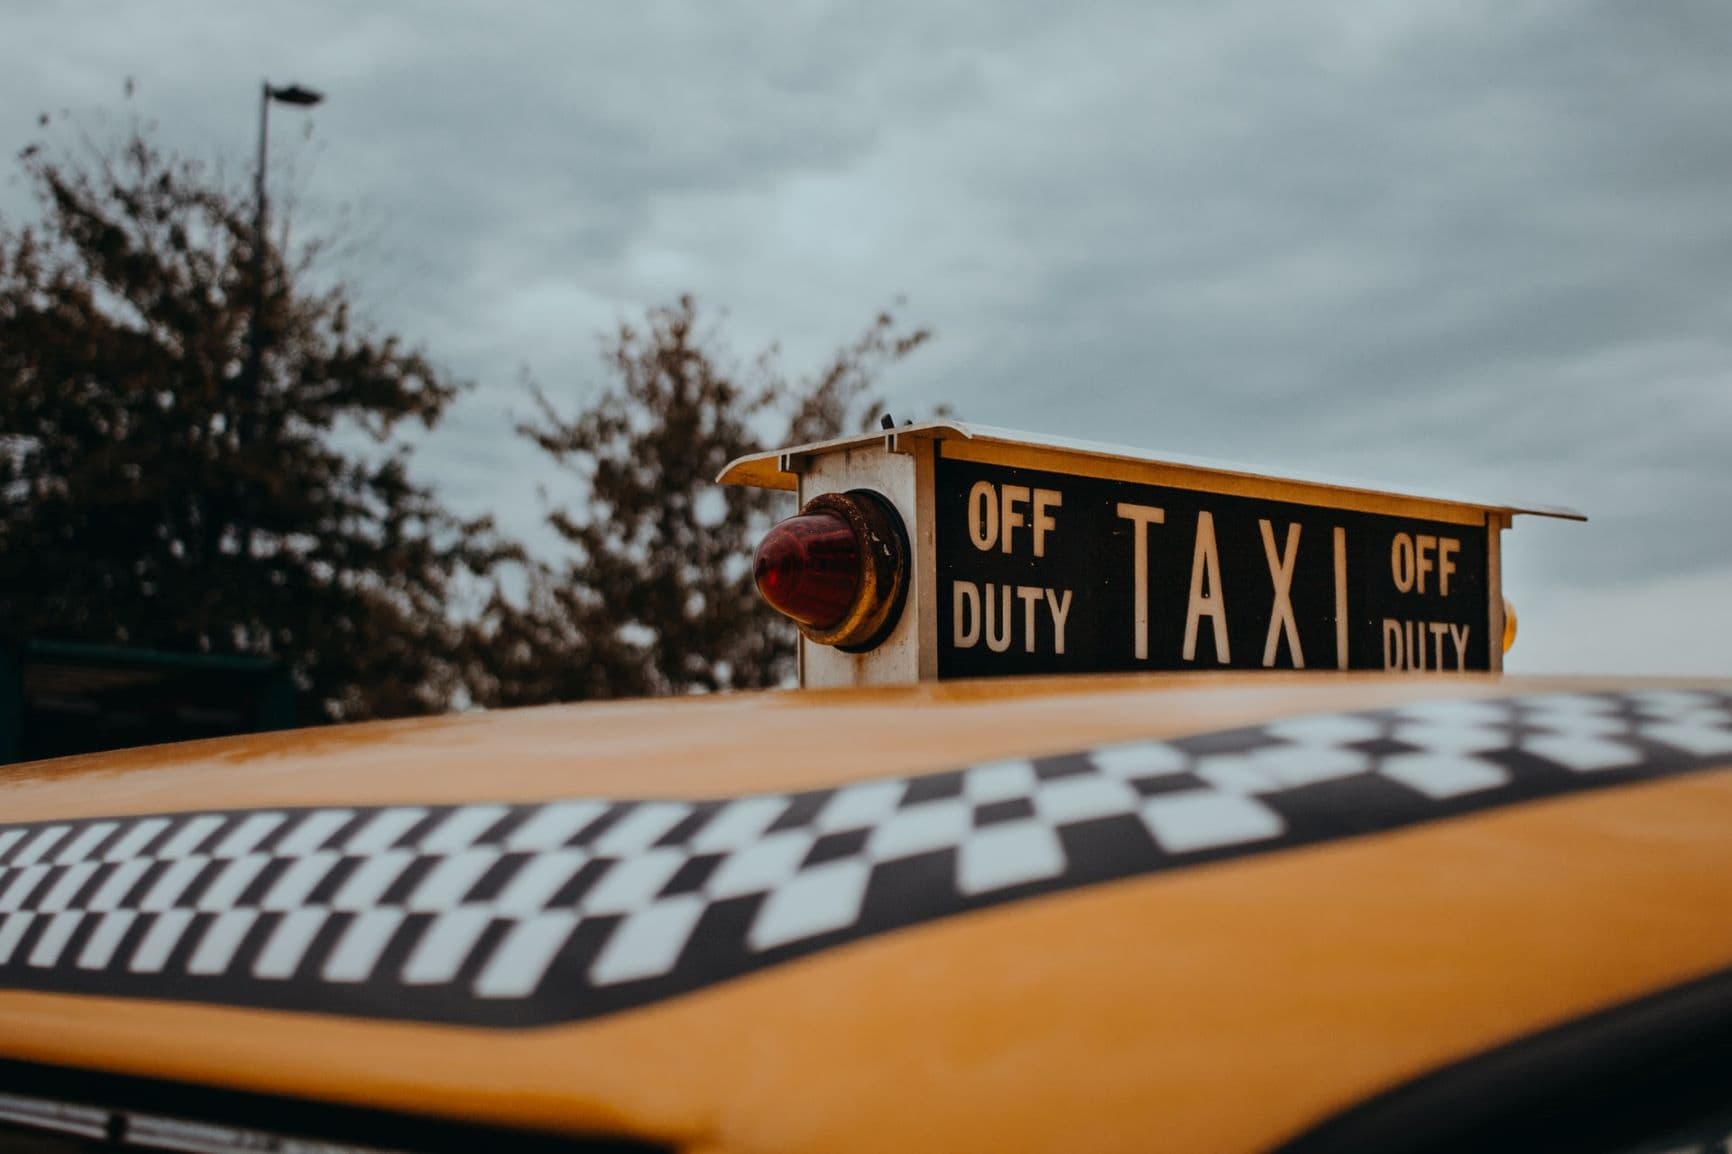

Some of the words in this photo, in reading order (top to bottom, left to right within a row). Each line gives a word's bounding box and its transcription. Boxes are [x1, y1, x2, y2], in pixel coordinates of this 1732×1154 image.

[968, 480, 1063, 557] OFF
[1117, 502, 1349, 670] TAXI
[1391, 532, 1460, 596] OFF
[953, 580, 1072, 655] DUTY
[1383, 618, 1470, 672] DUTY
